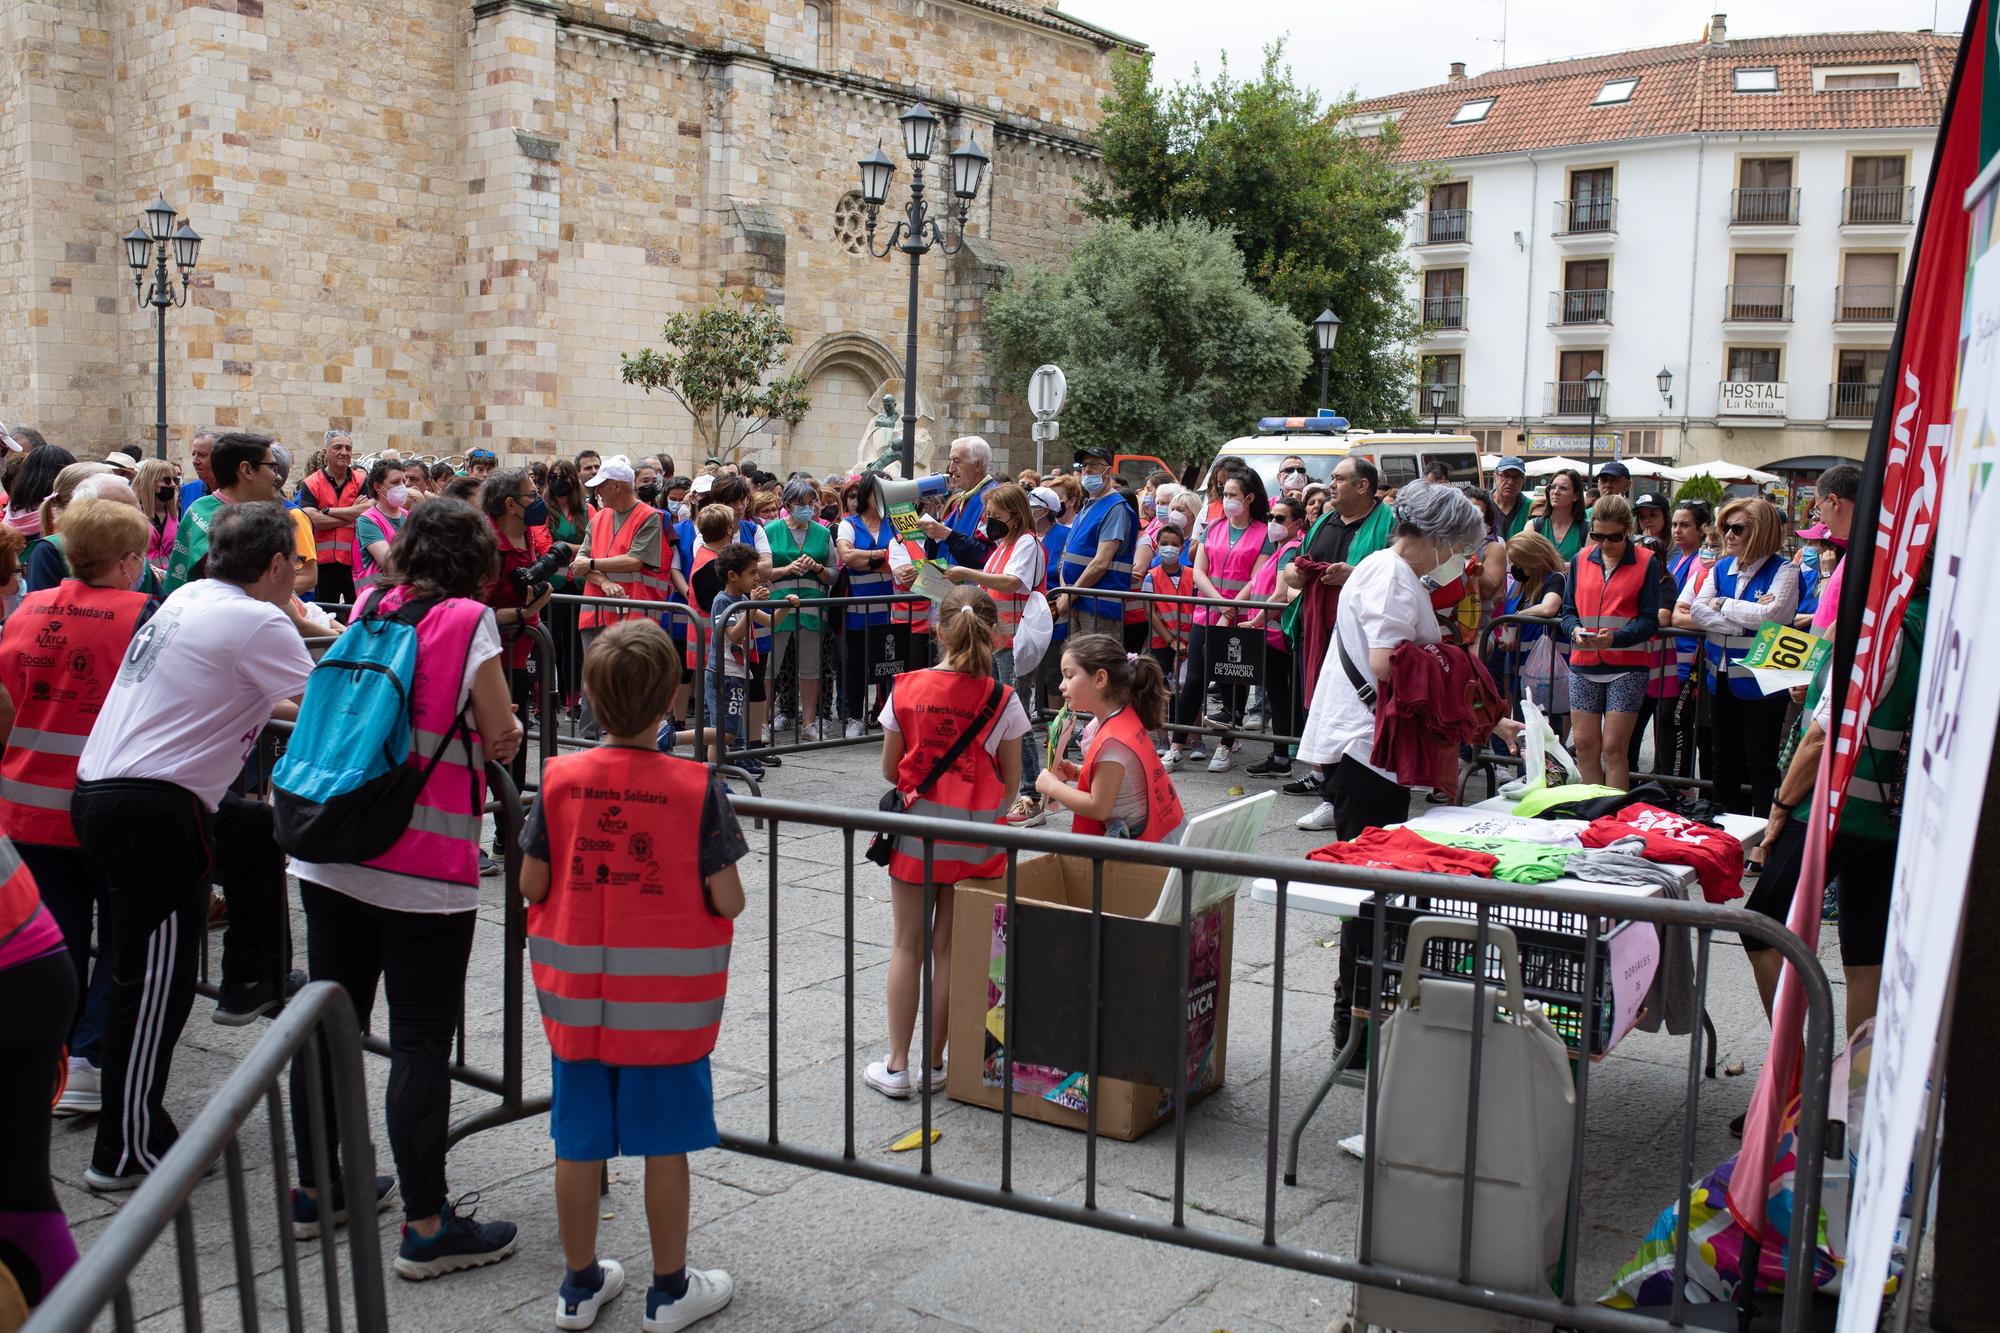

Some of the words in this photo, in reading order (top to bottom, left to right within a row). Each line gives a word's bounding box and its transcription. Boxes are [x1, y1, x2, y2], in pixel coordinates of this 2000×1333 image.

[1723, 383, 1784, 399] HOSTAL
[1727, 399, 1740, 409] La
[1745, 399, 1774, 409] Reina
[67, 604, 115, 620] Solidaria
[1214, 666, 1223, 675] DE
[1224, 667, 1254, 678] ZAMORA
[1215, 662, 1254, 671] AYUNTAMIENTO
[584, 787, 621, 800] Marcha
[624, 788, 668, 805] Solidaria
